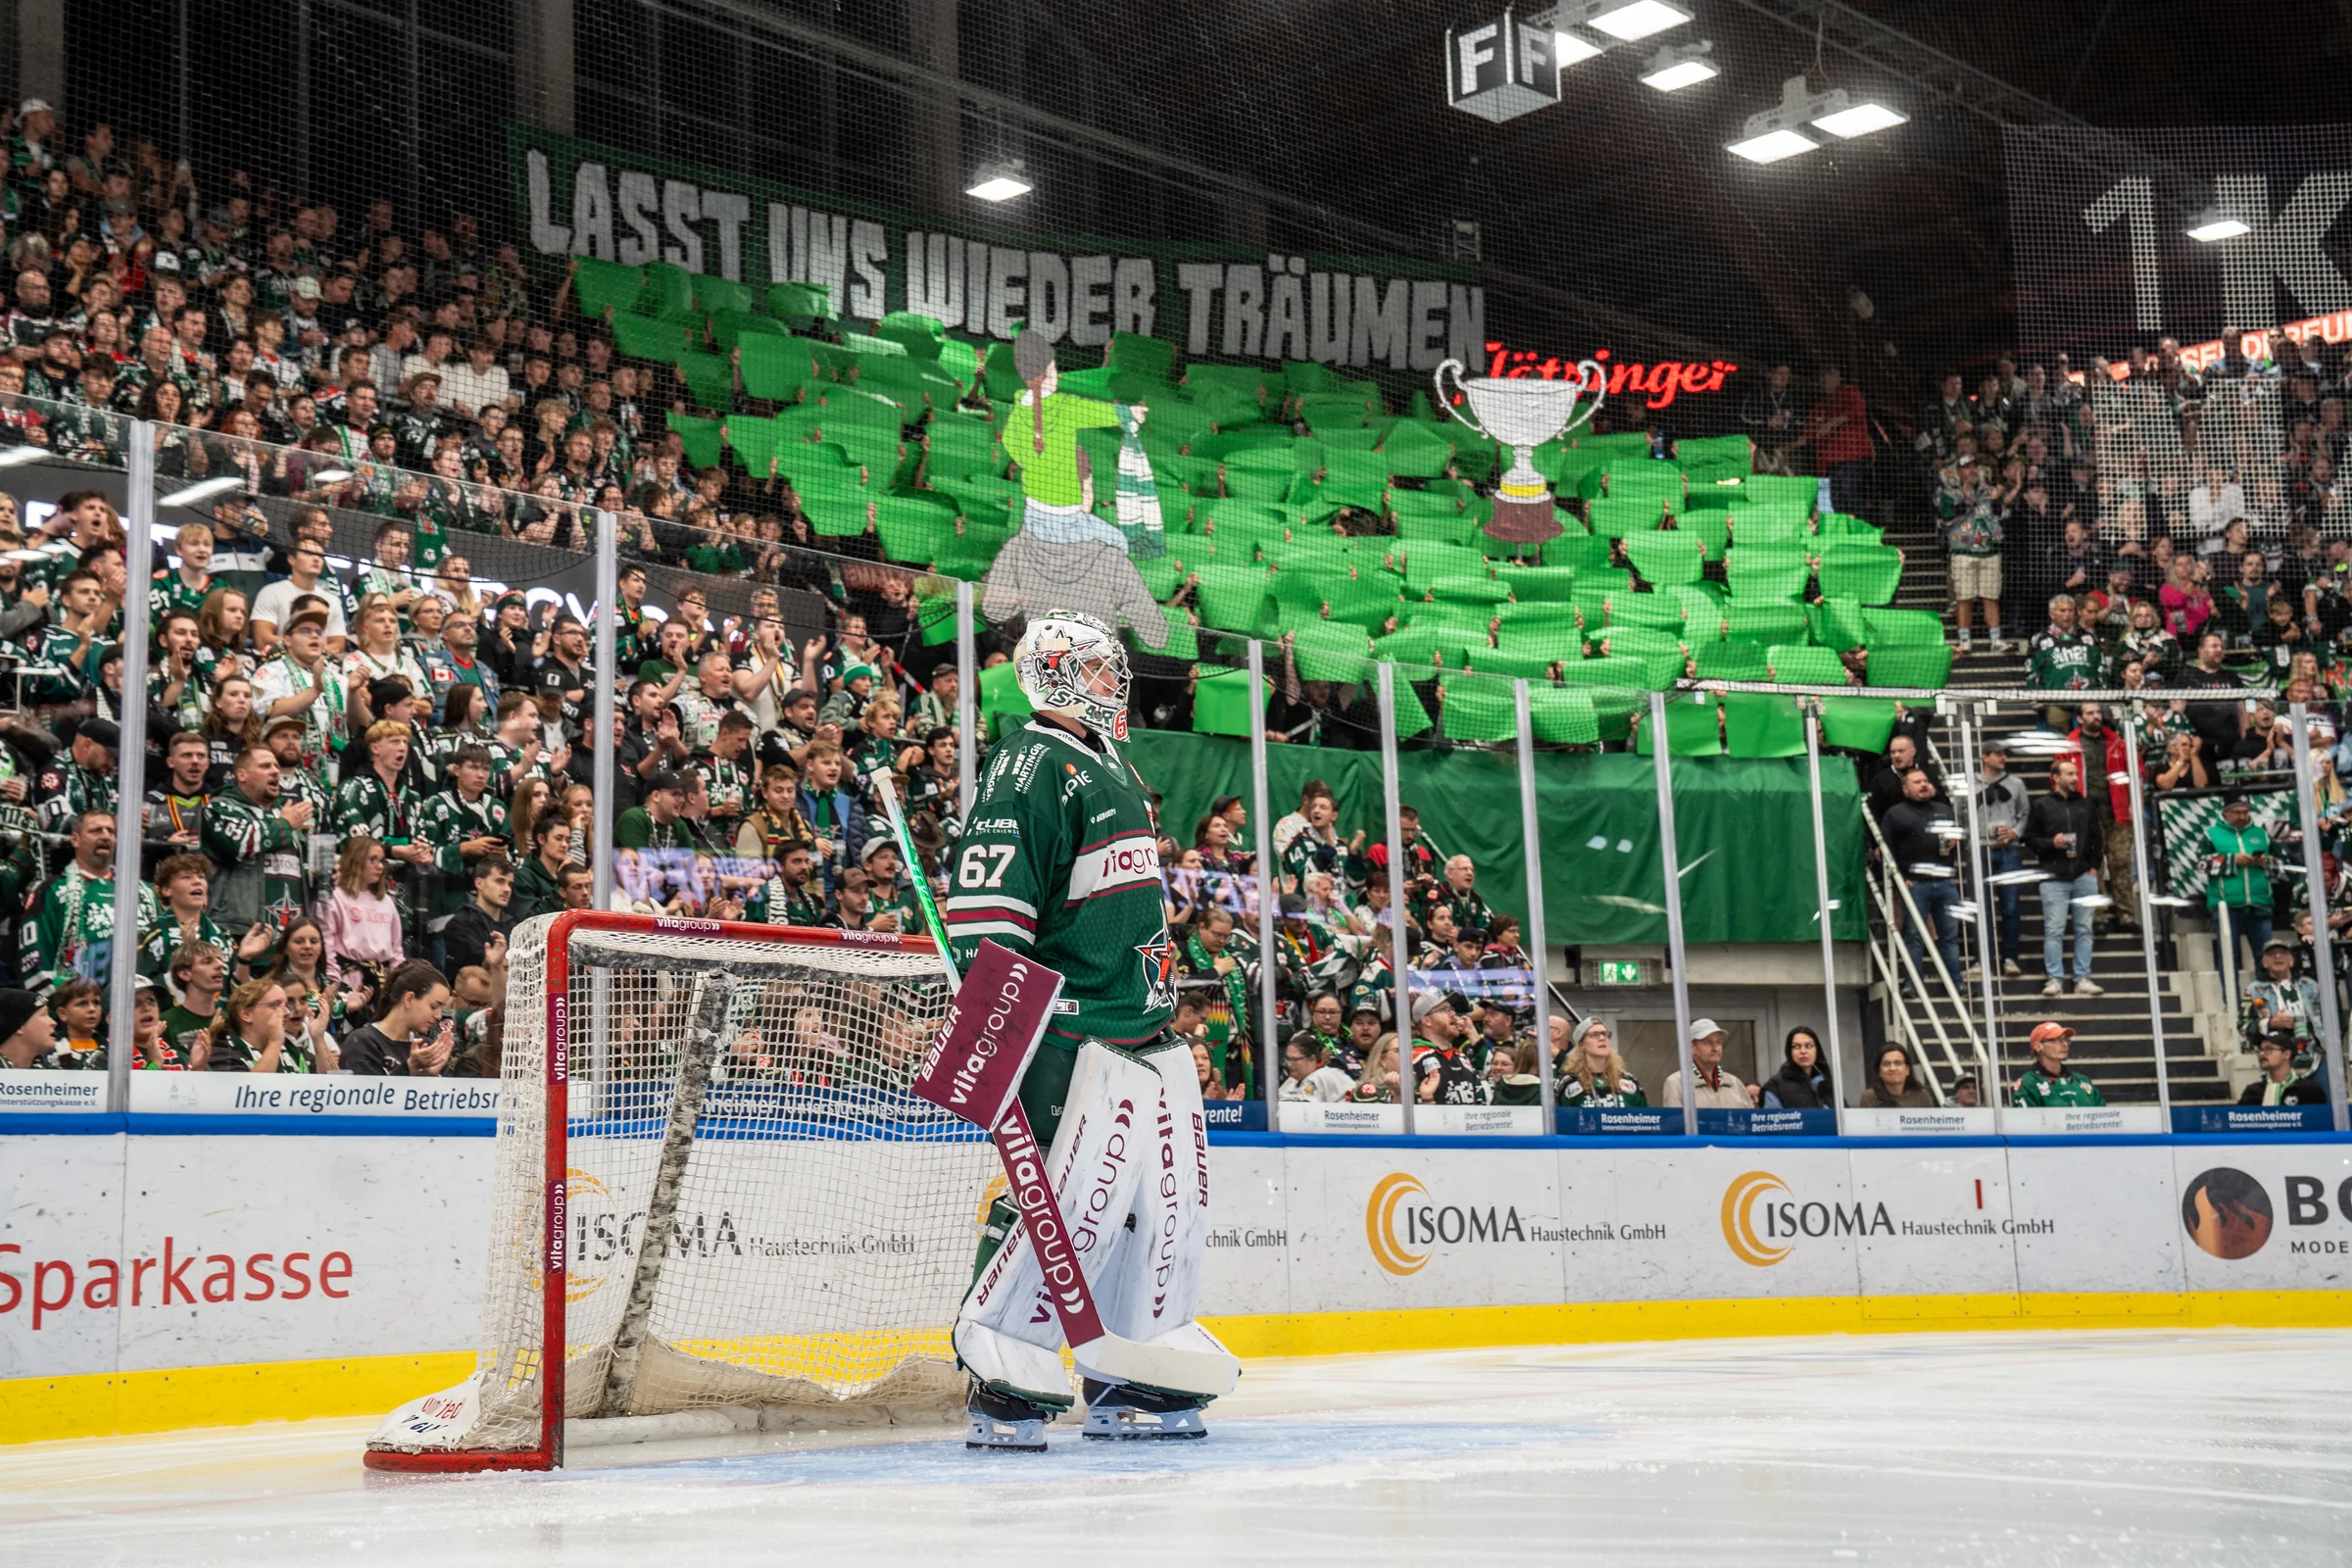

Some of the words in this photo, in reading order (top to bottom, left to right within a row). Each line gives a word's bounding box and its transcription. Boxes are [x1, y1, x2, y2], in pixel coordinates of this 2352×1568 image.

[527, 148, 751, 283] LASST
[768, 202, 888, 322] UNS
[906, 230, 1156, 347] WIEDER
[1179, 253, 1485, 373] TRÄUMEN
[958, 844, 1016, 888] 67
[656, 916, 715, 933] vitagroup
[842, 931, 892, 945] vitagroup
[556, 1008, 567, 1080] vitagroup
[921, 1005, 962, 1082] BAUER
[949, 982, 1020, 1104] vitagroup
[0, 1098, 82, 1108] nterstützungskasse
[235, 1085, 281, 1108] Ihre
[288, 1082, 395, 1113] regionale
[404, 1087, 501, 1110] Betriebsr
[1324, 1110, 1380, 1122] Rosenheimer
[1464, 1110, 1478, 1119] Ihre
[1480, 1109, 1512, 1122] regionale
[1601, 1112, 1660, 1124] Rosenheimer
[1751, 1112, 1765, 1122] Ihre
[1767, 1110, 1801, 1124] regionale
[1899, 1114, 1965, 1125] Rosenheimer
[2065, 1112, 2081, 1121] Ihre
[2082, 1109, 2121, 1122] regionale
[2228, 1110, 2303, 1123] Rosenheimer
[1465, 1121, 1513, 1131] Betriebsrente!
[1751, 1122, 1803, 1133] Betriebsrente!
[2066, 1119, 2124, 1132] Betriebsrente!
[1191, 1111, 1208, 1207] BAUER
[1000, 1114, 1074, 1287] vitagroup
[1407, 1205, 1525, 1245] ISOMA
[1531, 1223, 1614, 1243] Haustechnik
[1620, 1223, 1667, 1242] GmbH
[1767, 1201, 1896, 1238] ISOMA
[1902, 1219, 1996, 1237] Haustechnik
[2001, 1217, 2055, 1236] GmbH
[551, 1196, 564, 1270] vitagroup
[1245, 1229, 1288, 1249] GmbH
[2290, 1241, 2350, 1254] MODE
[0, 1237, 354, 1331] Sparkasse
